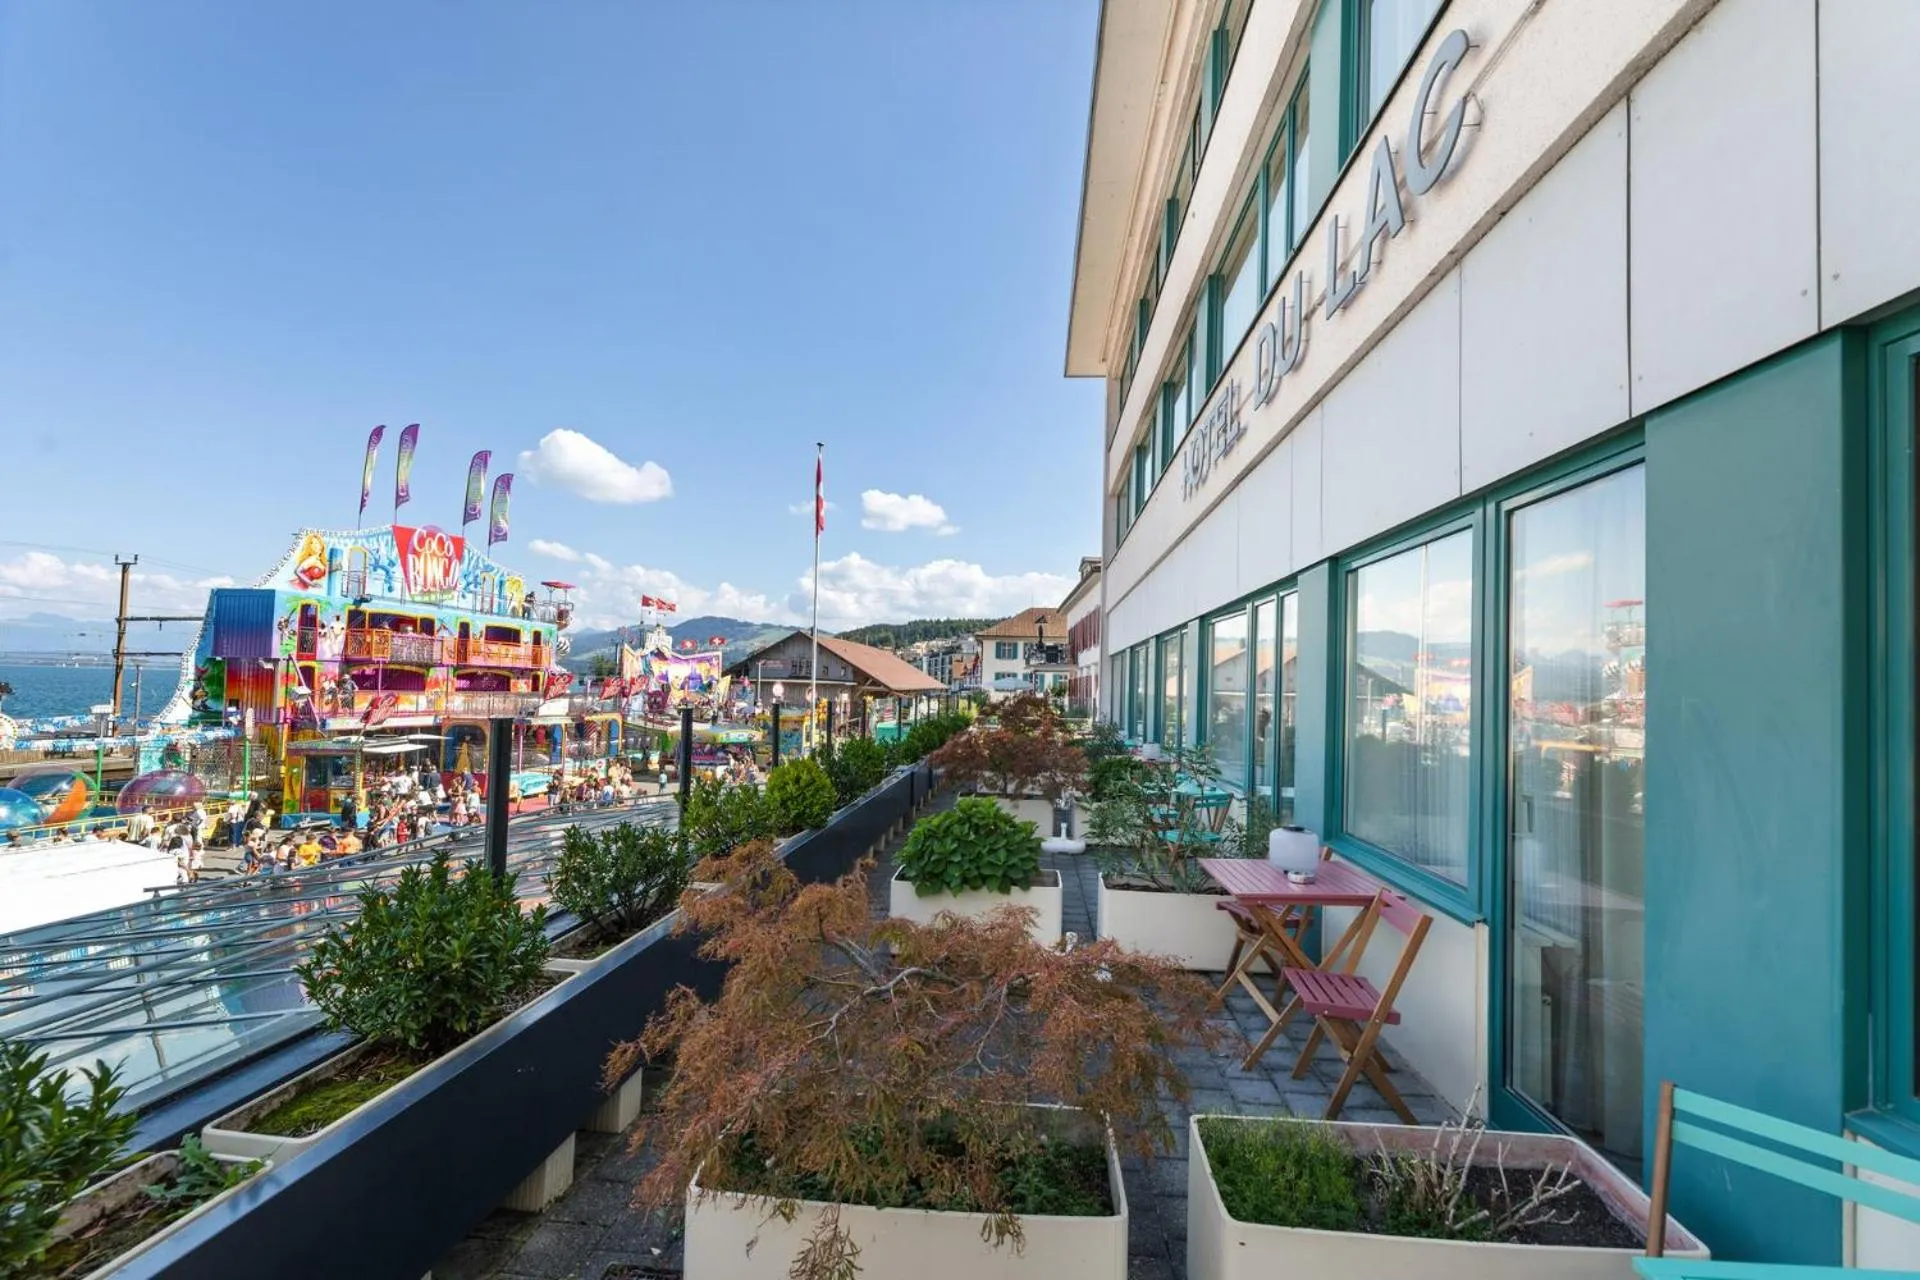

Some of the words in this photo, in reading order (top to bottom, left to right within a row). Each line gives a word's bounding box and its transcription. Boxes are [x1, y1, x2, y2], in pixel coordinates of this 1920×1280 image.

[1182, 378, 1241, 499] HOTEL
[1253, 269, 1303, 411] DU
[1325, 28, 1470, 321] LAC
[407, 551, 460, 595] BONGO
